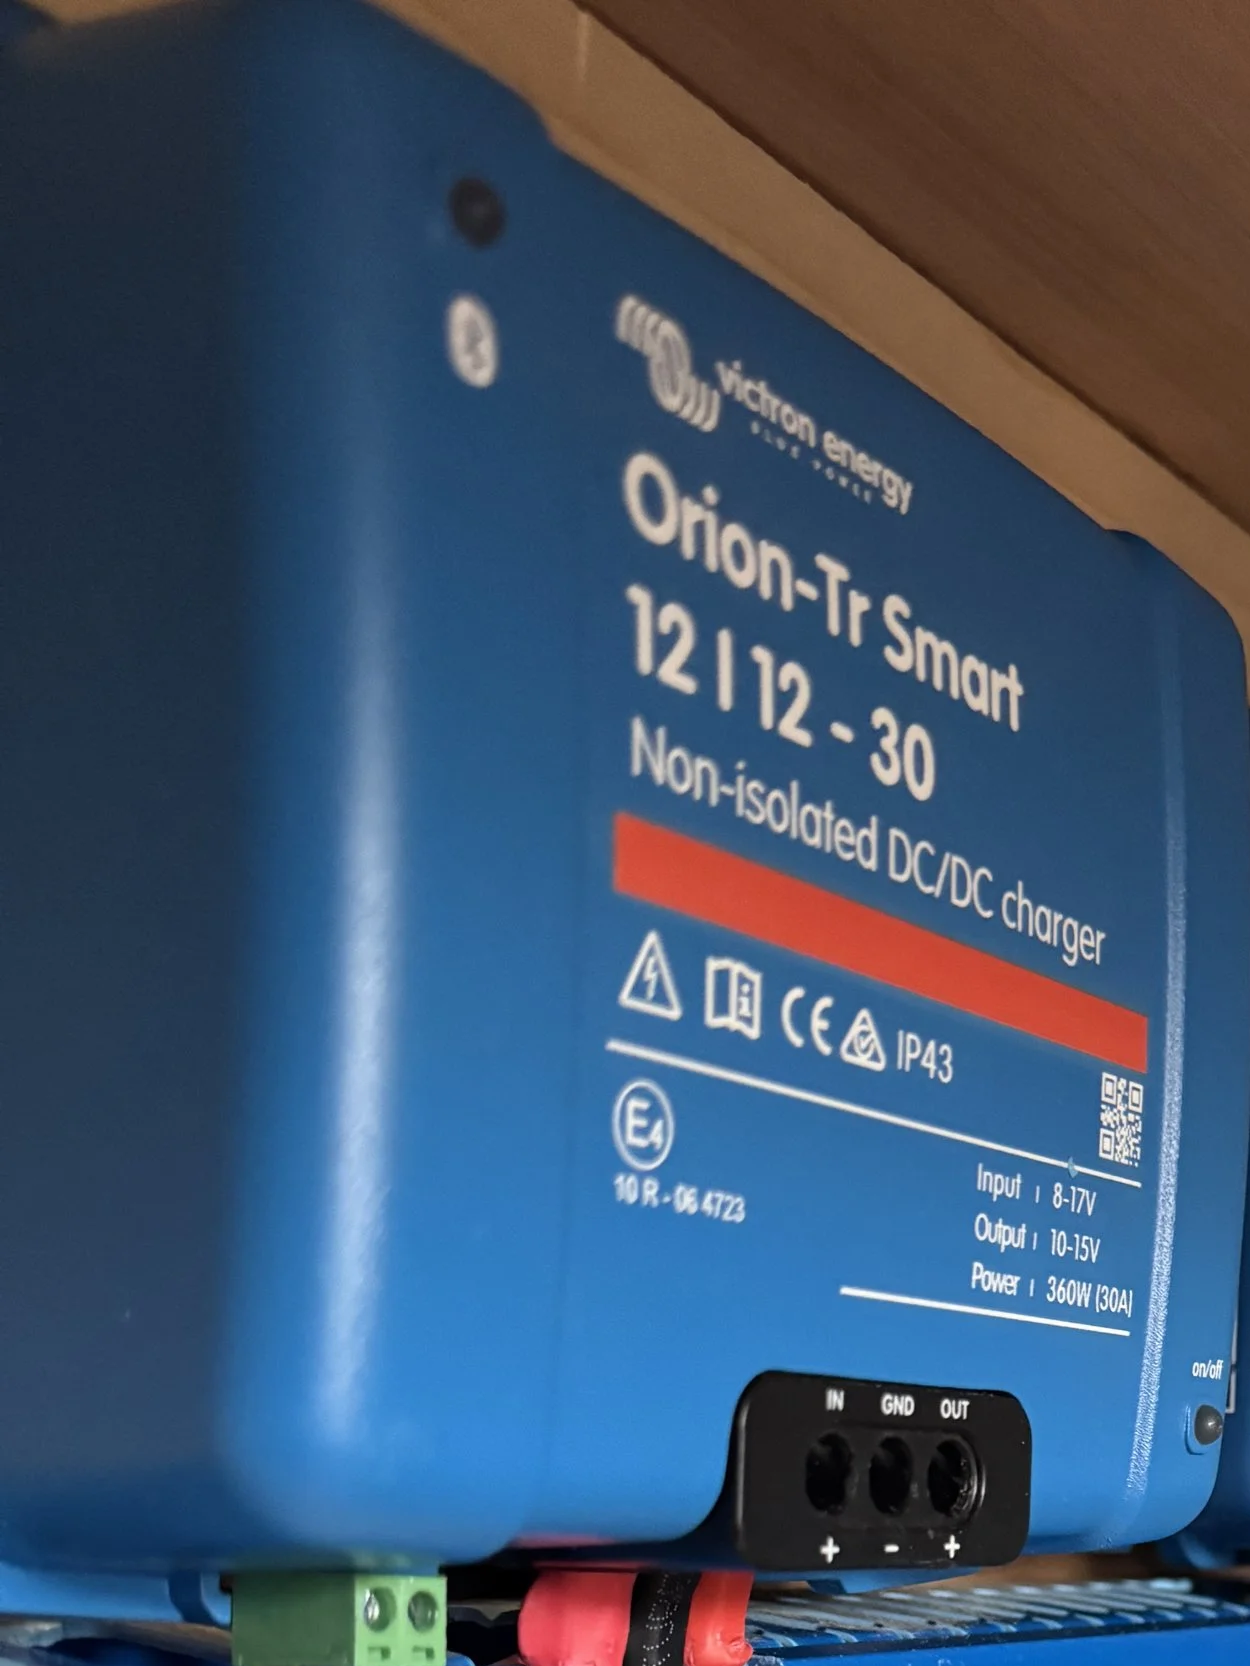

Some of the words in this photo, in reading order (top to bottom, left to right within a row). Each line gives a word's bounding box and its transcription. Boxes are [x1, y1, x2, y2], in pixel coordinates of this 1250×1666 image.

[714, 359, 816, 448] victron
[822, 430, 913, 515] energy
[623, 451, 871, 648] Orion-Tr
[882, 594, 1024, 733] Smart
[626, 583, 698, 695] 12
[750, 645, 814, 748] 12
[869, 706, 936, 801] 30
[630, 715, 879, 871] Non-isolated
[888, 828, 995, 918] DC/DC
[1001, 881, 1107, 967] charger
[897, 1030, 953, 1083] IP43
[614, 1172, 639, 1205] 10
[642, 1177, 659, 1208] R
[977, 1163, 1022, 1202] Input
[1052, 1182, 1097, 1216] 8-17V
[974, 1213, 1027, 1253] Output
[1050, 1228, 1101, 1263] 10-15V
[971, 1261, 1021, 1296] Power
[1046, 1276, 1092, 1308] 360W
[1095, 1284, 1133, 1318] (30A)
[1192, 1359, 1224, 1380] on/off
[825, 1388, 845, 1412] IN
[881, 1392, 915, 1417] GND
[939, 1398, 970, 1420] OUT
